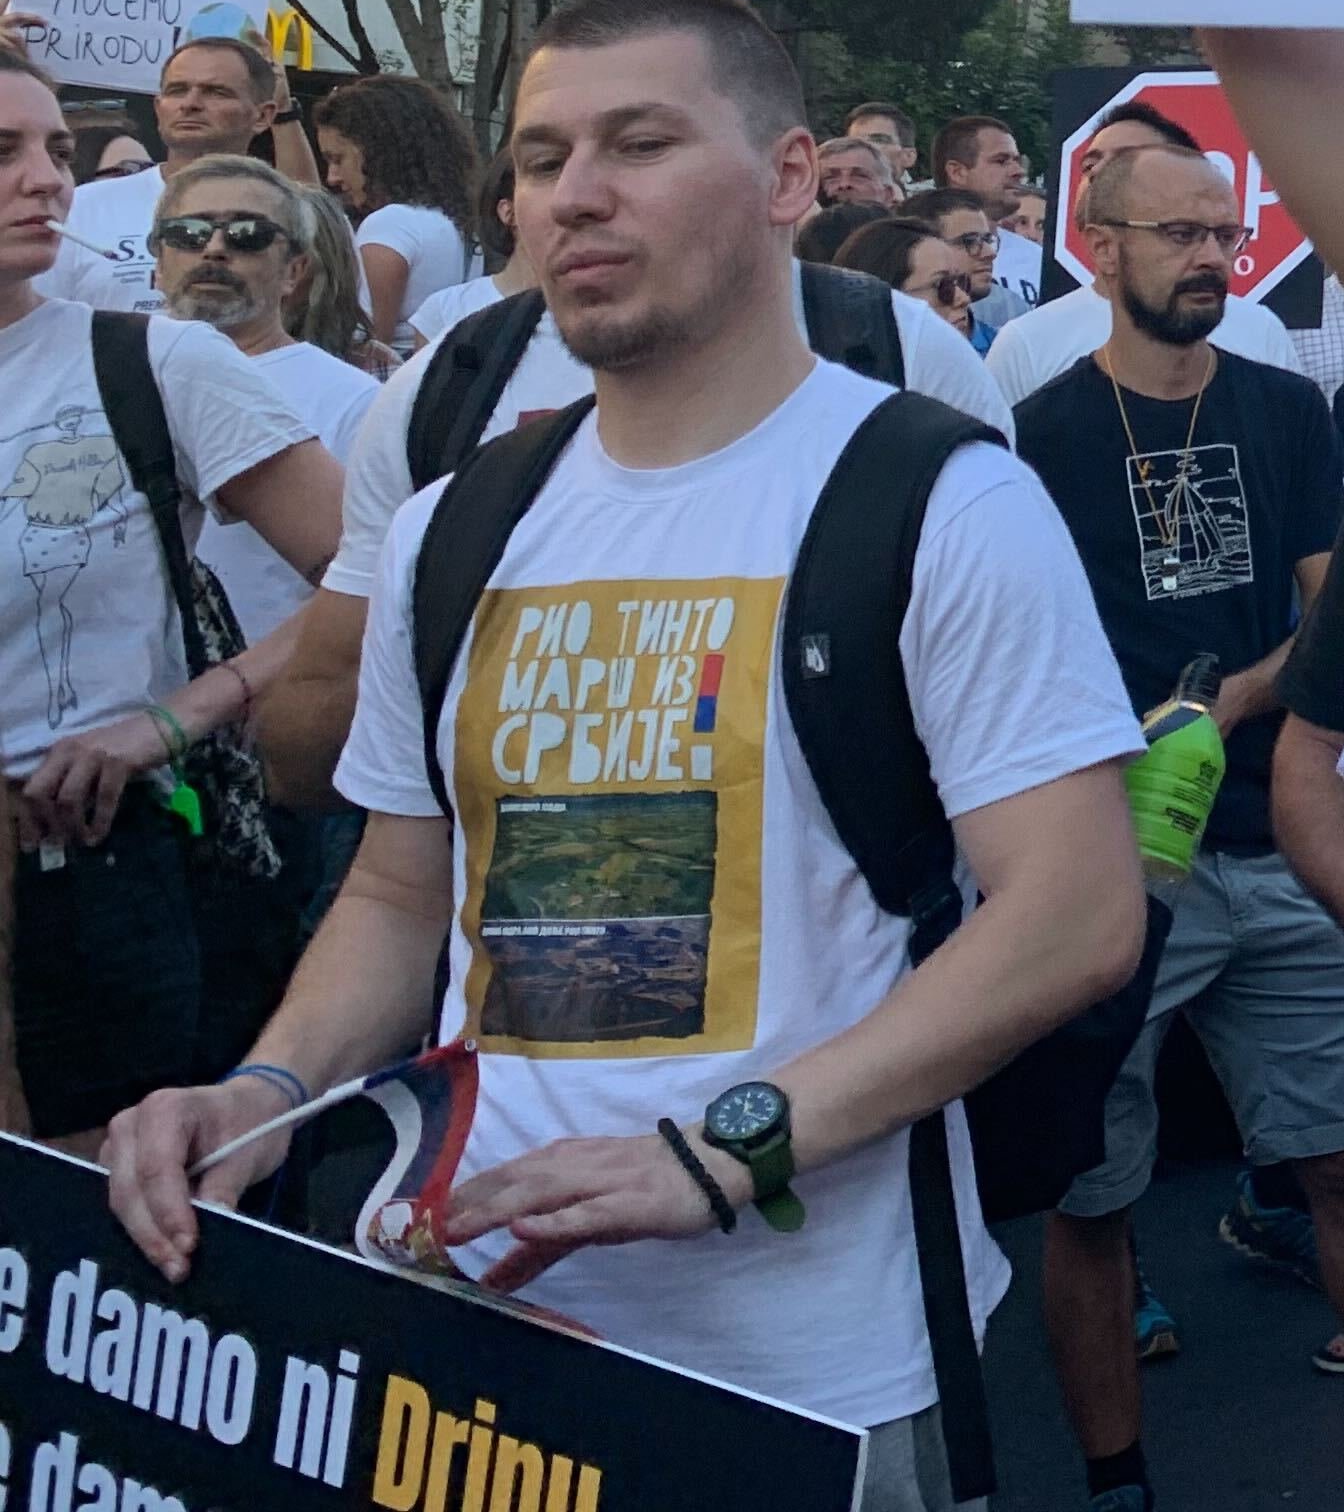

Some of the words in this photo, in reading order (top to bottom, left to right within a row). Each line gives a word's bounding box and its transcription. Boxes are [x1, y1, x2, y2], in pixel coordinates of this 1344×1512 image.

[509, 600, 592, 659] РИО
[617, 597, 735, 656] ТИНТО
[498, 657, 636, 713] МАРШ
[652, 655, 696, 706] ИЗ
[45, 1257, 256, 1446] damo
[273, 1348, 361, 1489] ni
